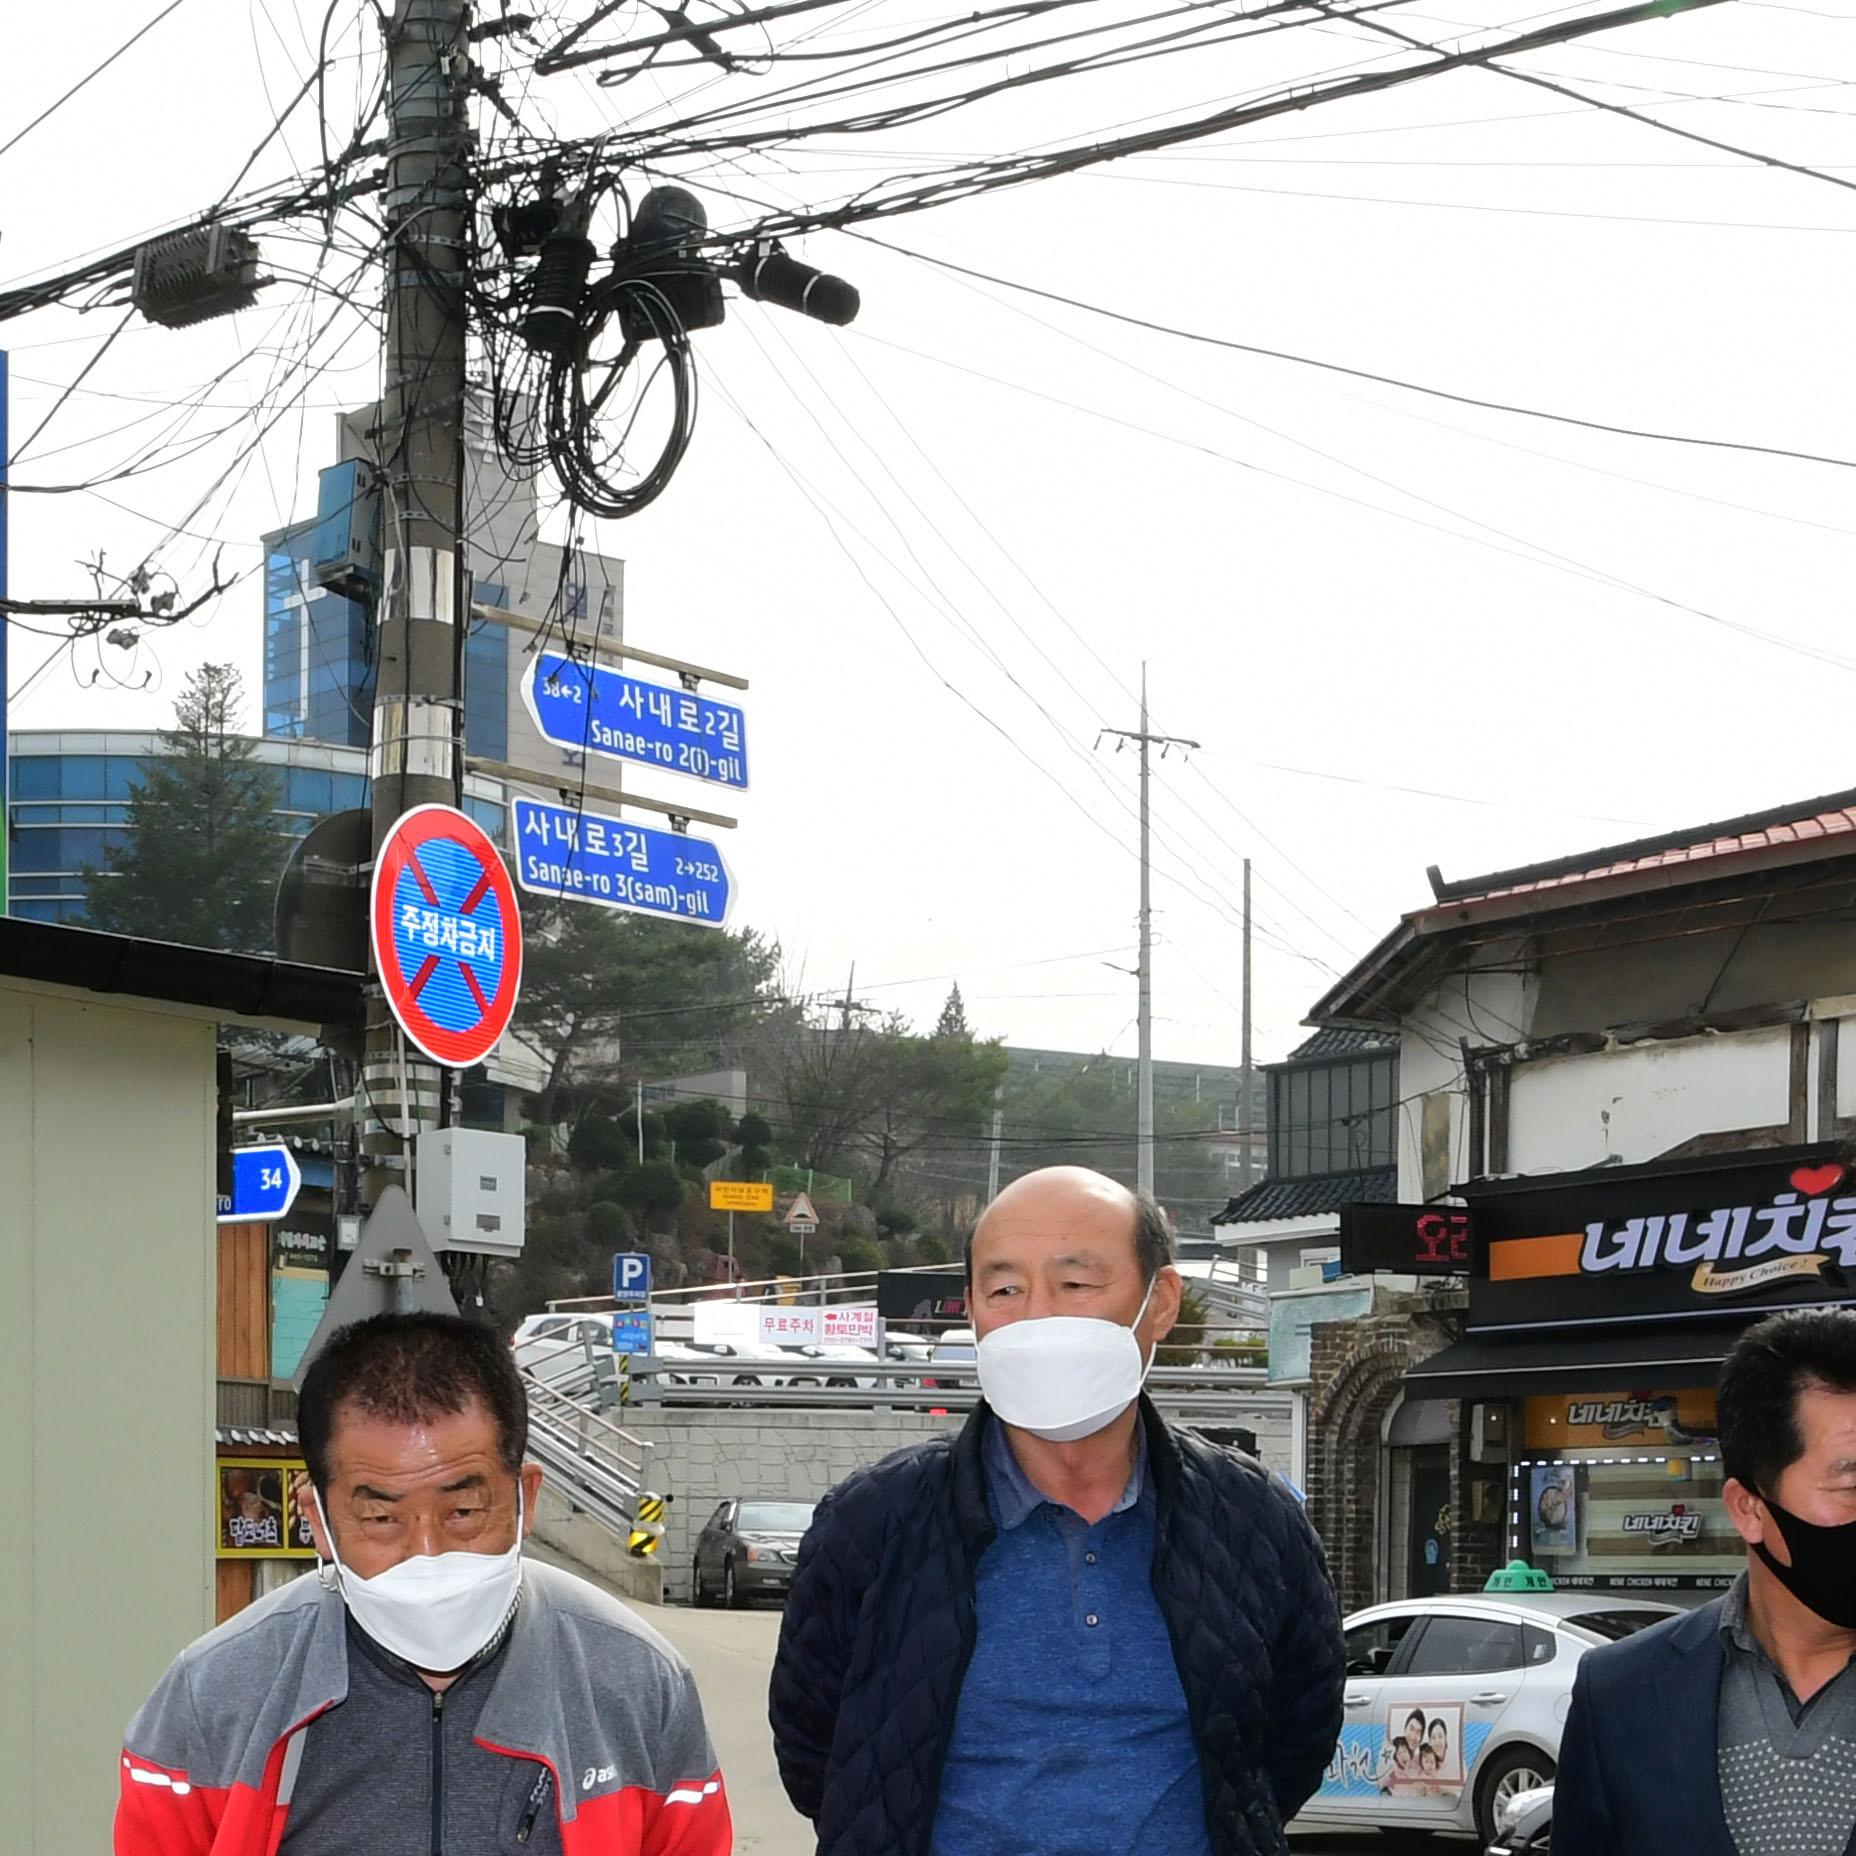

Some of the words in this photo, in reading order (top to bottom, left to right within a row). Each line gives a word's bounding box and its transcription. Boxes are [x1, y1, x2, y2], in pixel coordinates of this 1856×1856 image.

[619, 684, 741, 752] 사내로2길
[591, 720, 673, 763] Sanae-ro
[679, 743, 742, 781] 2(i)-gil
[525, 810, 650, 873] 사내로3길
[528, 855, 611, 895] Sanae-ro
[616, 873, 710, 915] 3(sam)-gil
[695, 861, 720, 883] 252
[400, 904, 496, 962] 주정차금지
[260, 1167, 283, 1191] 34
[622, 1257, 643, 1288] P
[1704, 1274, 1746, 1289] Happy
[1749, 1260, 1799, 1281] Choice
[764, 1317, 814, 1334] 무료주차
[825, 1323, 873, 1337] 황토민박
[839, 1311, 874, 1323] 사계절
[1623, 1514, 1700, 1538] 네네치킨
